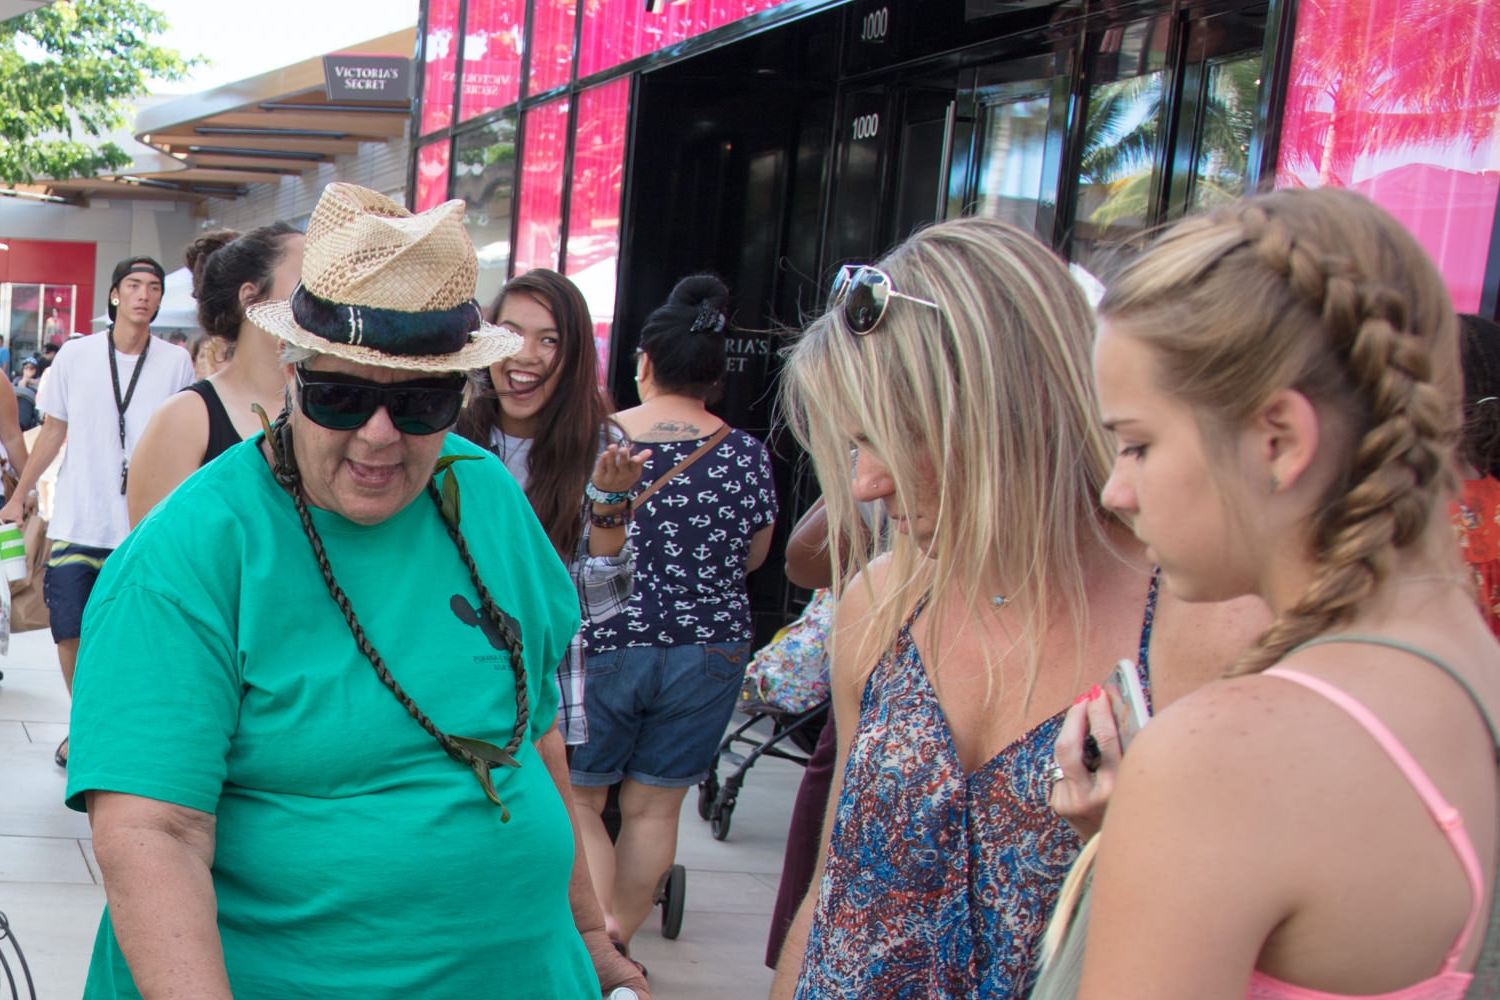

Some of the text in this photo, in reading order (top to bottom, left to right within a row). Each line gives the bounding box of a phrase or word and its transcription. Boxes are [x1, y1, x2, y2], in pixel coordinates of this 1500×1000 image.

[334, 65, 399, 79] VICTORIA'S
[344, 78, 387, 91] SECRET
[853, 112, 879, 140] 1000
